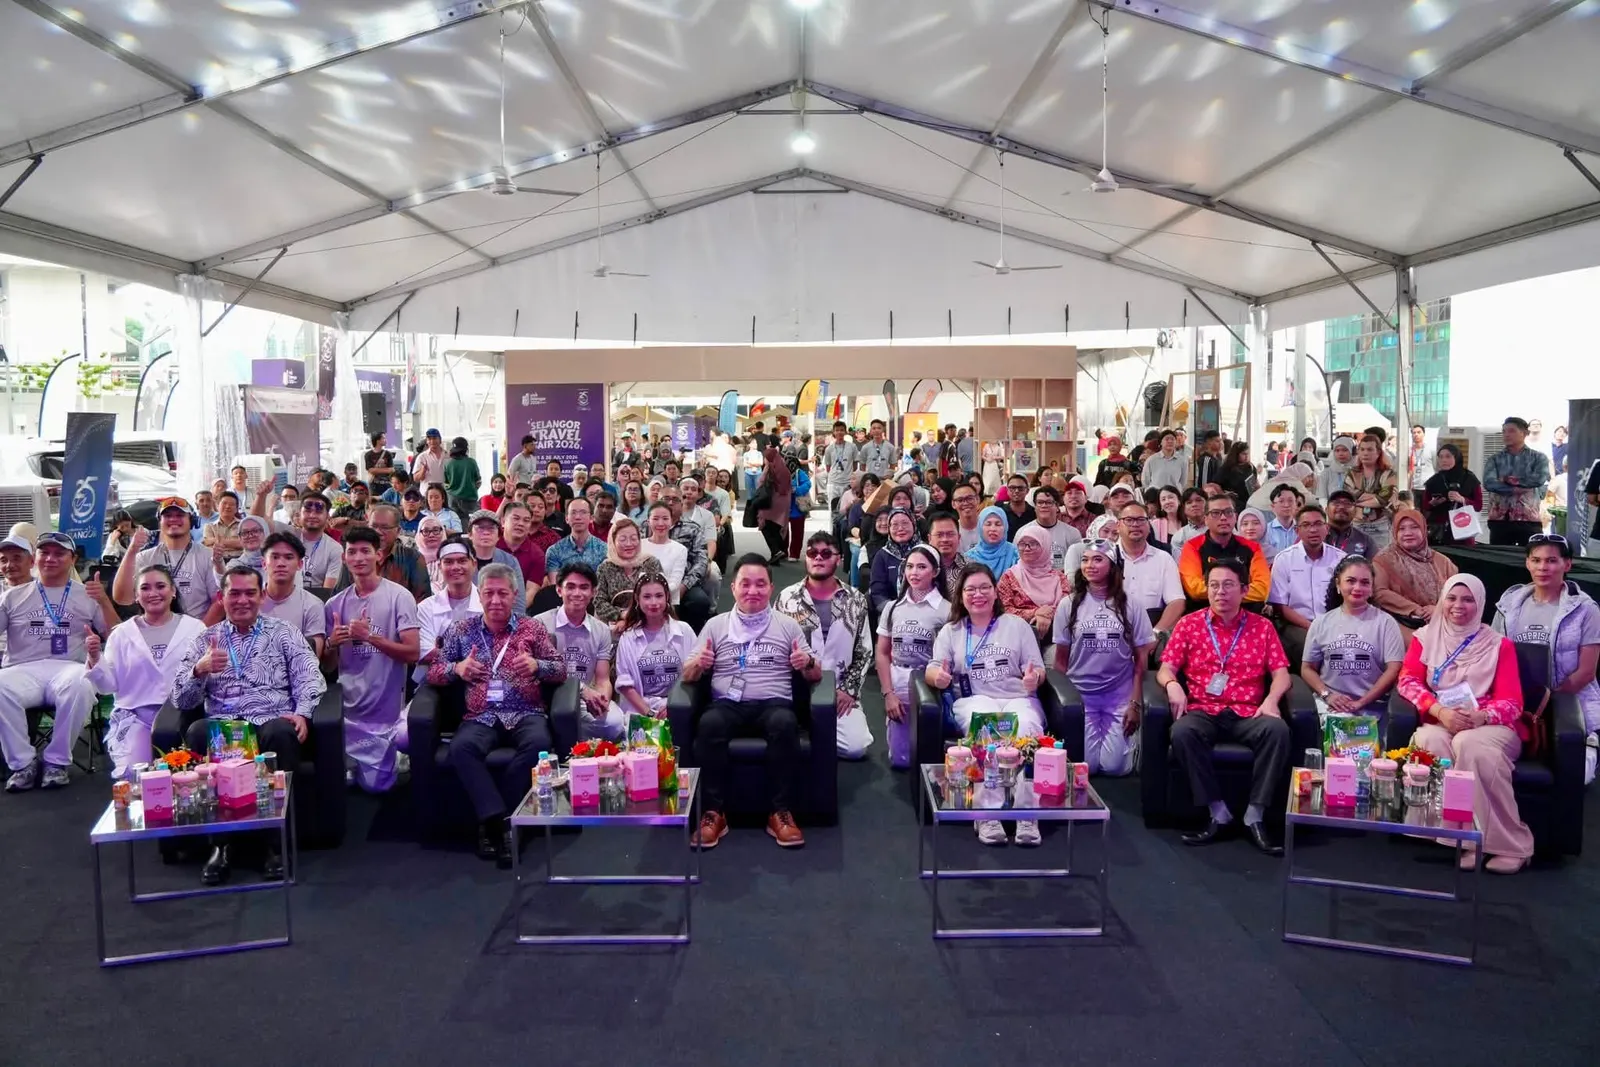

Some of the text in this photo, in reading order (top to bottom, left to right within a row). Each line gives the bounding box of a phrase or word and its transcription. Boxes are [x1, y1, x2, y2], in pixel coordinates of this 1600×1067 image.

[530, 420, 581, 430] SELANGOR
[529, 429, 581, 441] TRAVEL
[1327, 639, 1374, 653] SURPRISING
[1329, 660, 1371, 670] SELANGOR
